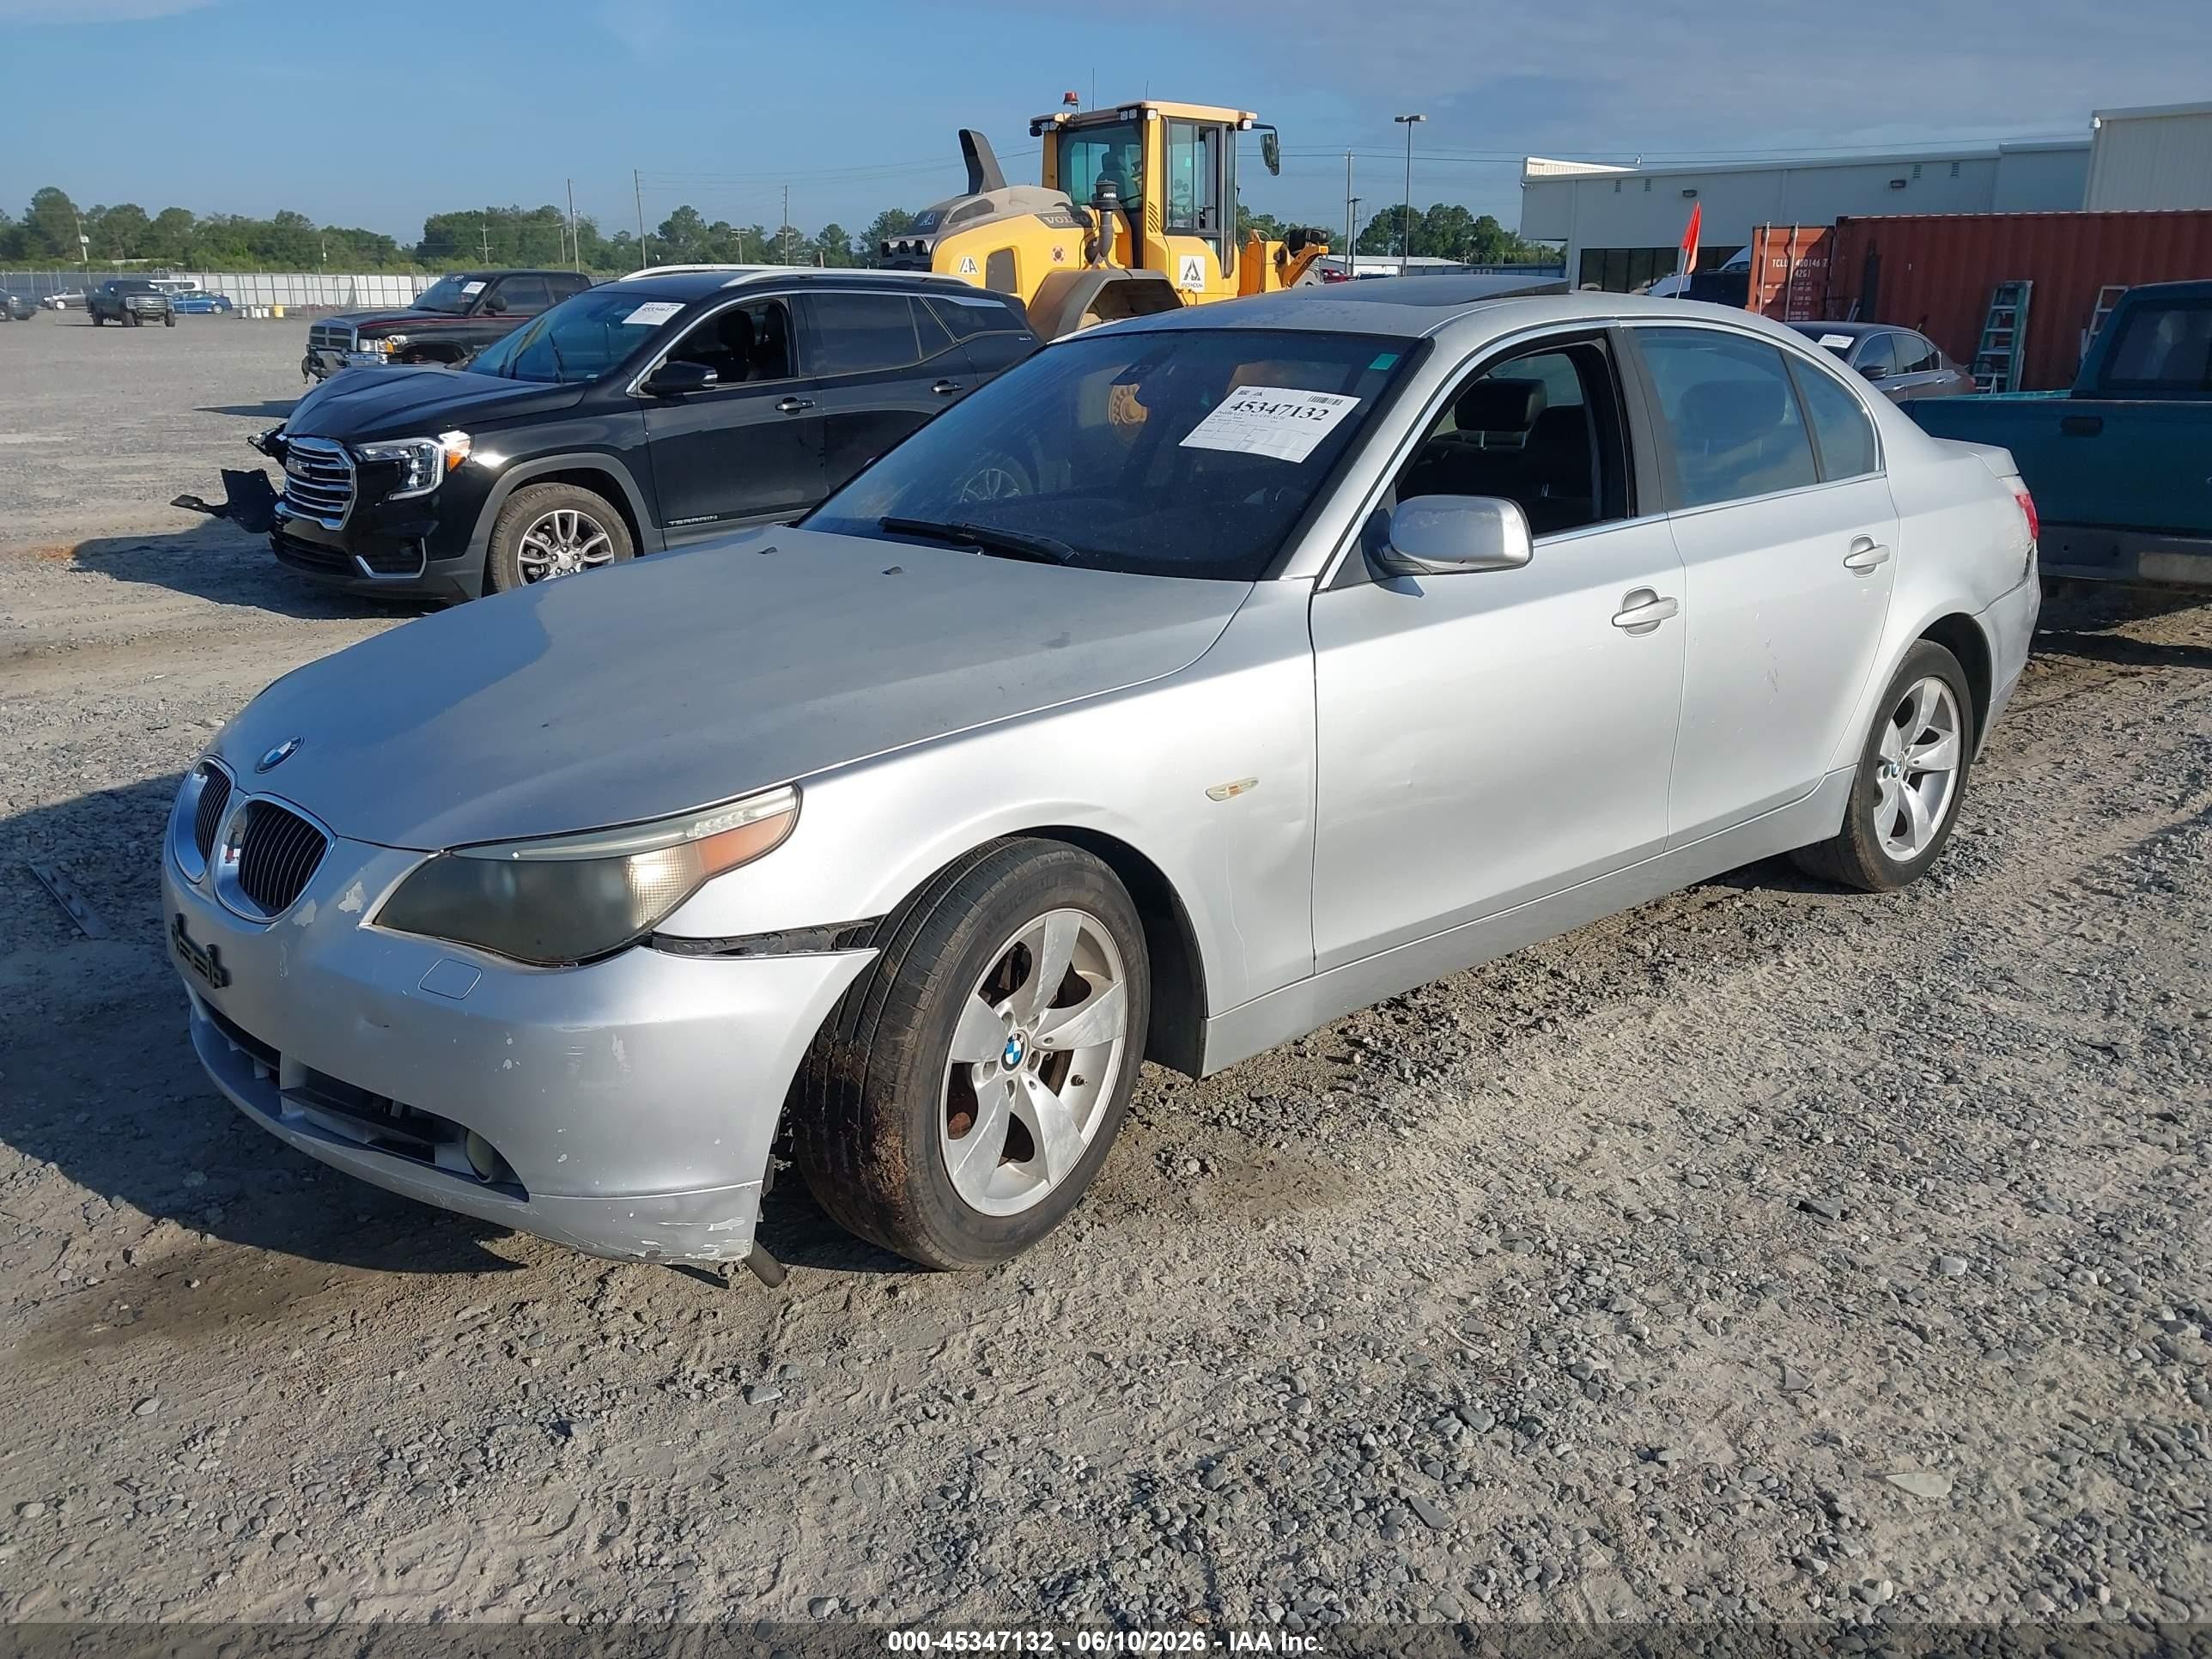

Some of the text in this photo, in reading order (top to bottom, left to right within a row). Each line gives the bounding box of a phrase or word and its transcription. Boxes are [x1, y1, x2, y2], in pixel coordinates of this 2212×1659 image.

[1042, 215, 1089, 224] VOLVO
[1796, 258, 1820, 268] 400146
[1230, 399, 1330, 422] 45347132
[668, 514, 719, 526] TERRAIN
